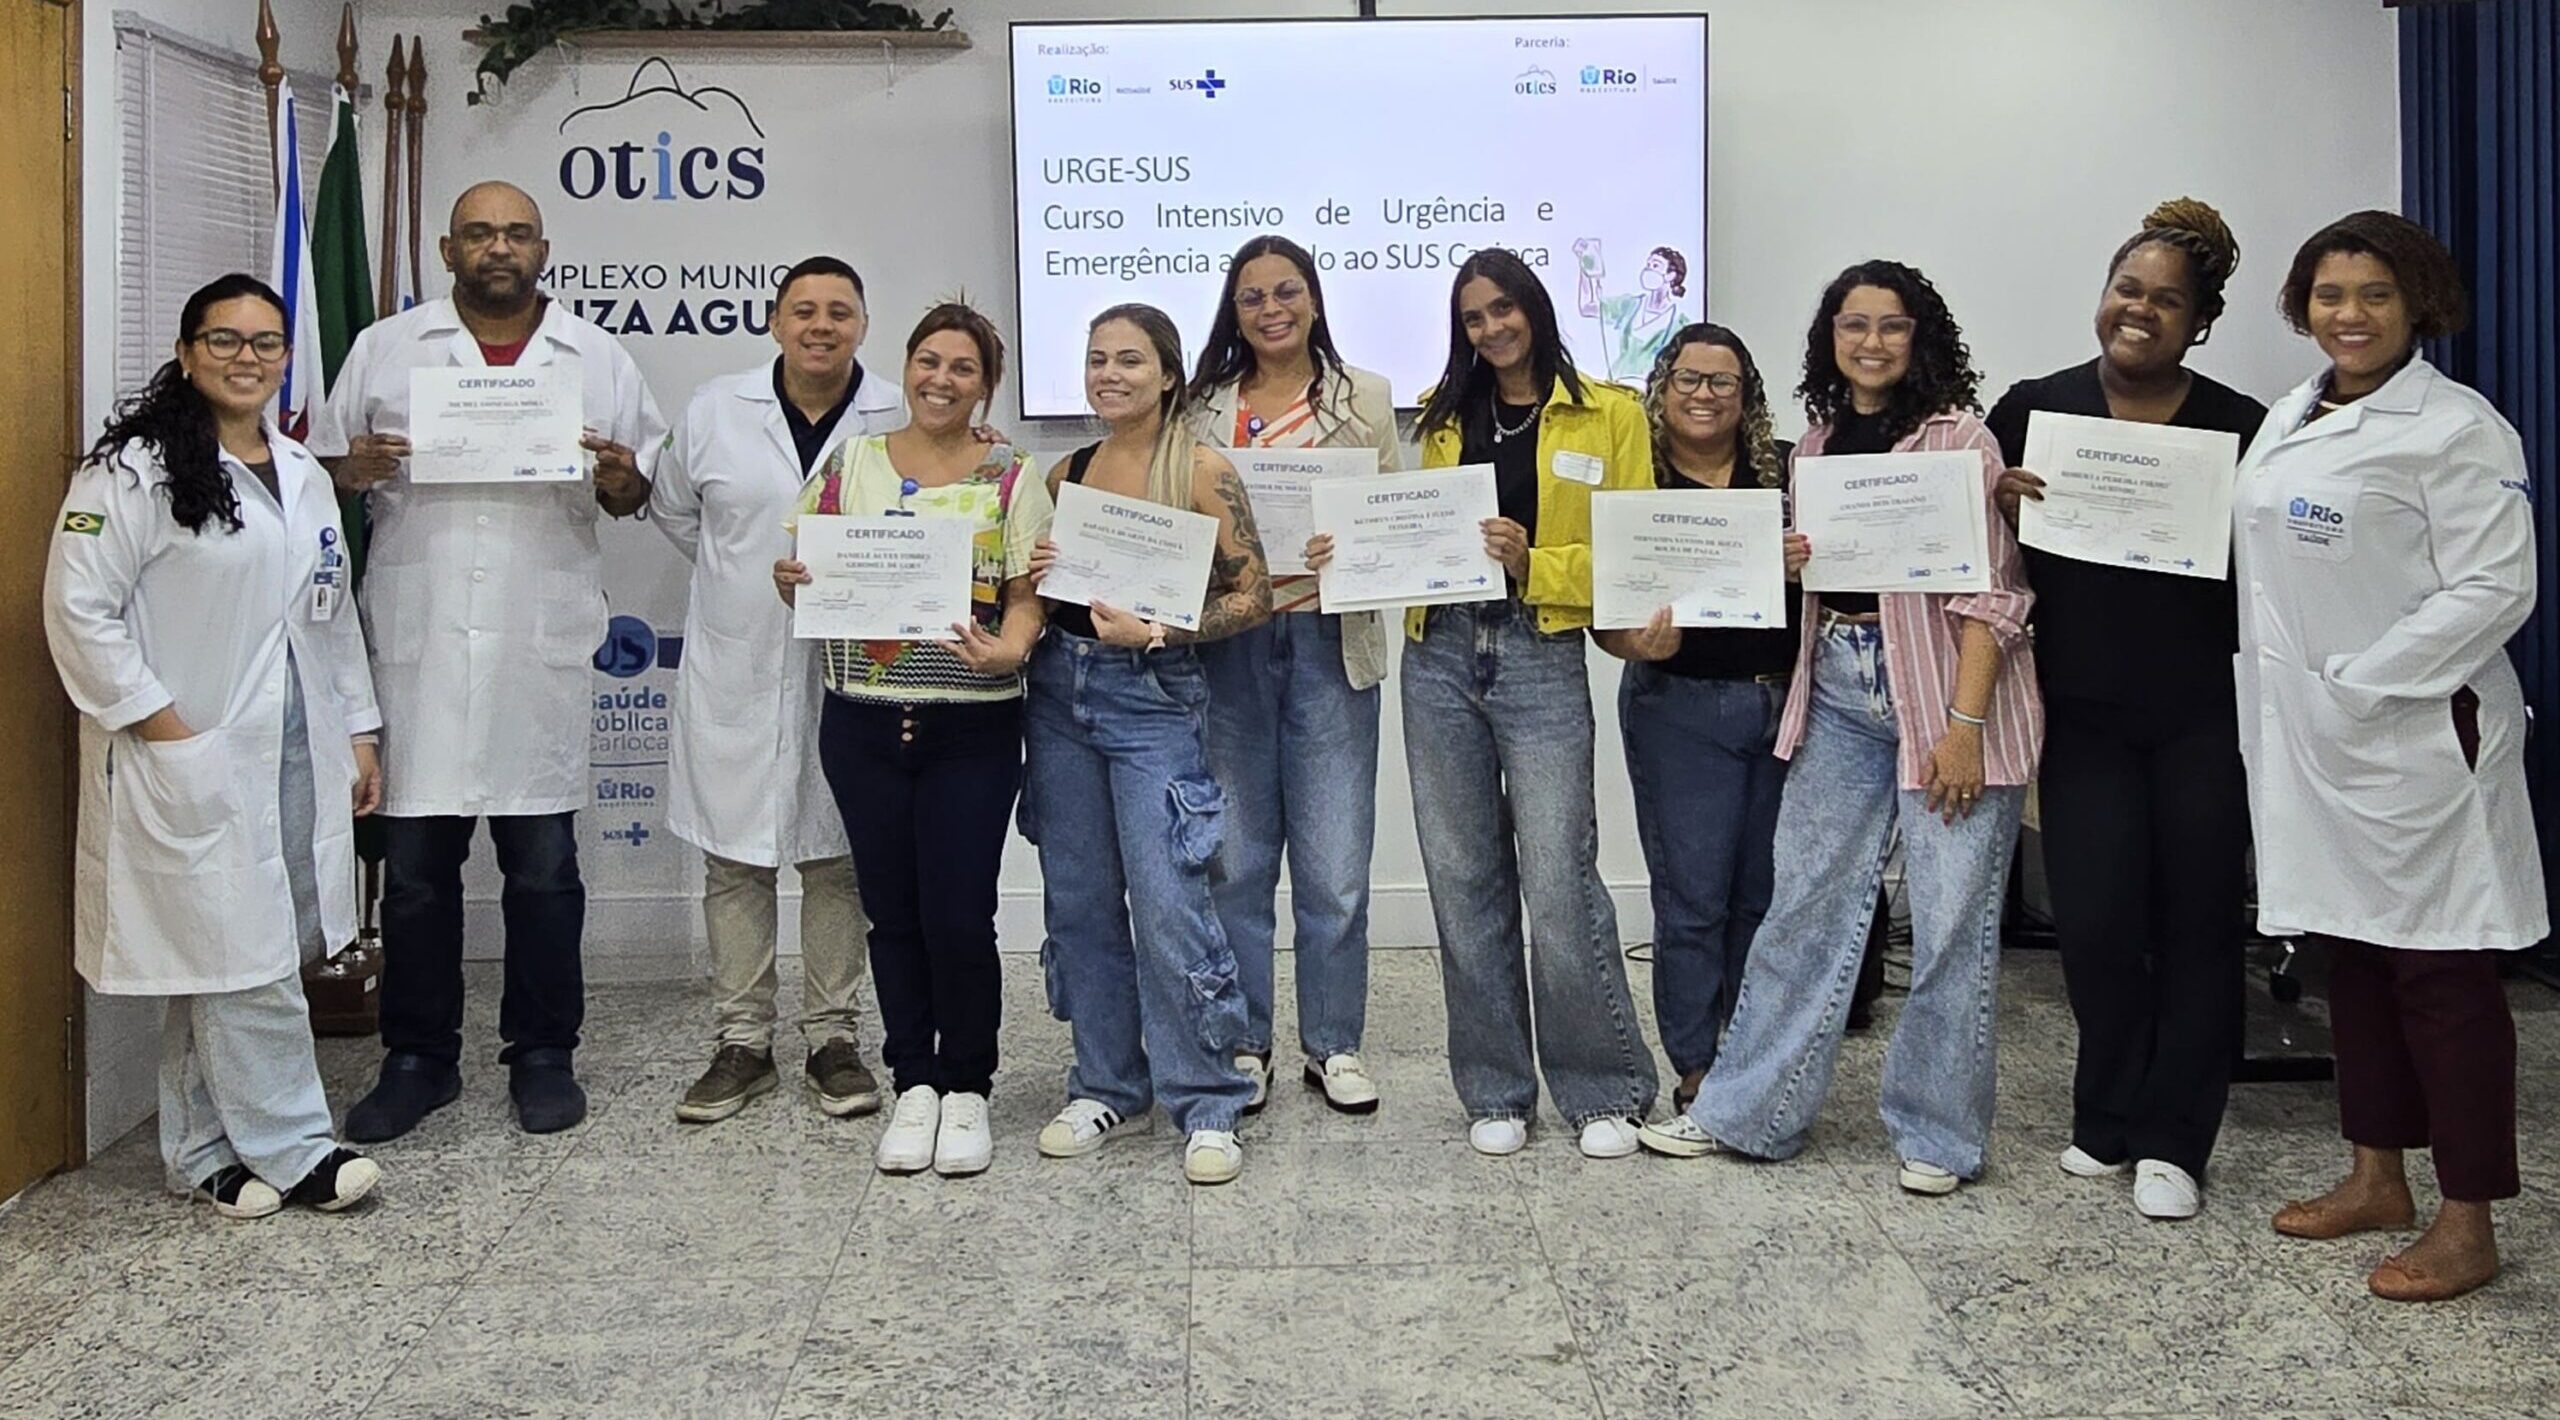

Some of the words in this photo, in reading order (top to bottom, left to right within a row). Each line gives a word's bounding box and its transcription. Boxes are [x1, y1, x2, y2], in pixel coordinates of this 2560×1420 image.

[1038, 43, 1110, 57] Realização:
[1515, 37, 1570, 48] Parceria:
[1169, 79, 1194, 91] SUS
[1603, 69, 1637, 85] Rio
[1069, 78, 1101, 95] Rio
[1515, 80, 1557, 95] otics
[559, 131, 765, 200] otics
[1043, 156, 1191, 184] URGE-SUS
[1044, 204, 1124, 230] Curso
[1157, 200, 1284, 228] Intensivo
[1315, 198, 1350, 225] de
[1383, 196, 1505, 230] Urgência
[1537, 201, 1554, 221] e
[1046, 246, 1210, 281] Emergência
[1344, 251, 1378, 270] ao
[1386, 243, 1440, 270] SUS
[538, 264, 667, 290] MPLEXO
[681, 264, 792, 290] MUNIC
[665, 299, 776, 336] AGU
[458, 378, 535, 389] CERTIFICADO
[2077, 448, 2160, 467] CERTIFICADO
[1253, 463, 1322, 474] CERTIFICADO
[1844, 474, 1918, 490] CERTIFICADO
[1367, 489, 1440, 505] CERTIFICADO
[1101, 504, 1173, 529] CERTIFICADO
[1652, 513, 1728, 527] CERTIFICADO
[2309, 503, 2343, 525] Rio
[846, 529, 925, 540] CERTIFICADO
[593, 636, 647, 671] US
[592, 711, 669, 732] ública
[621, 782, 655, 799] Rio
